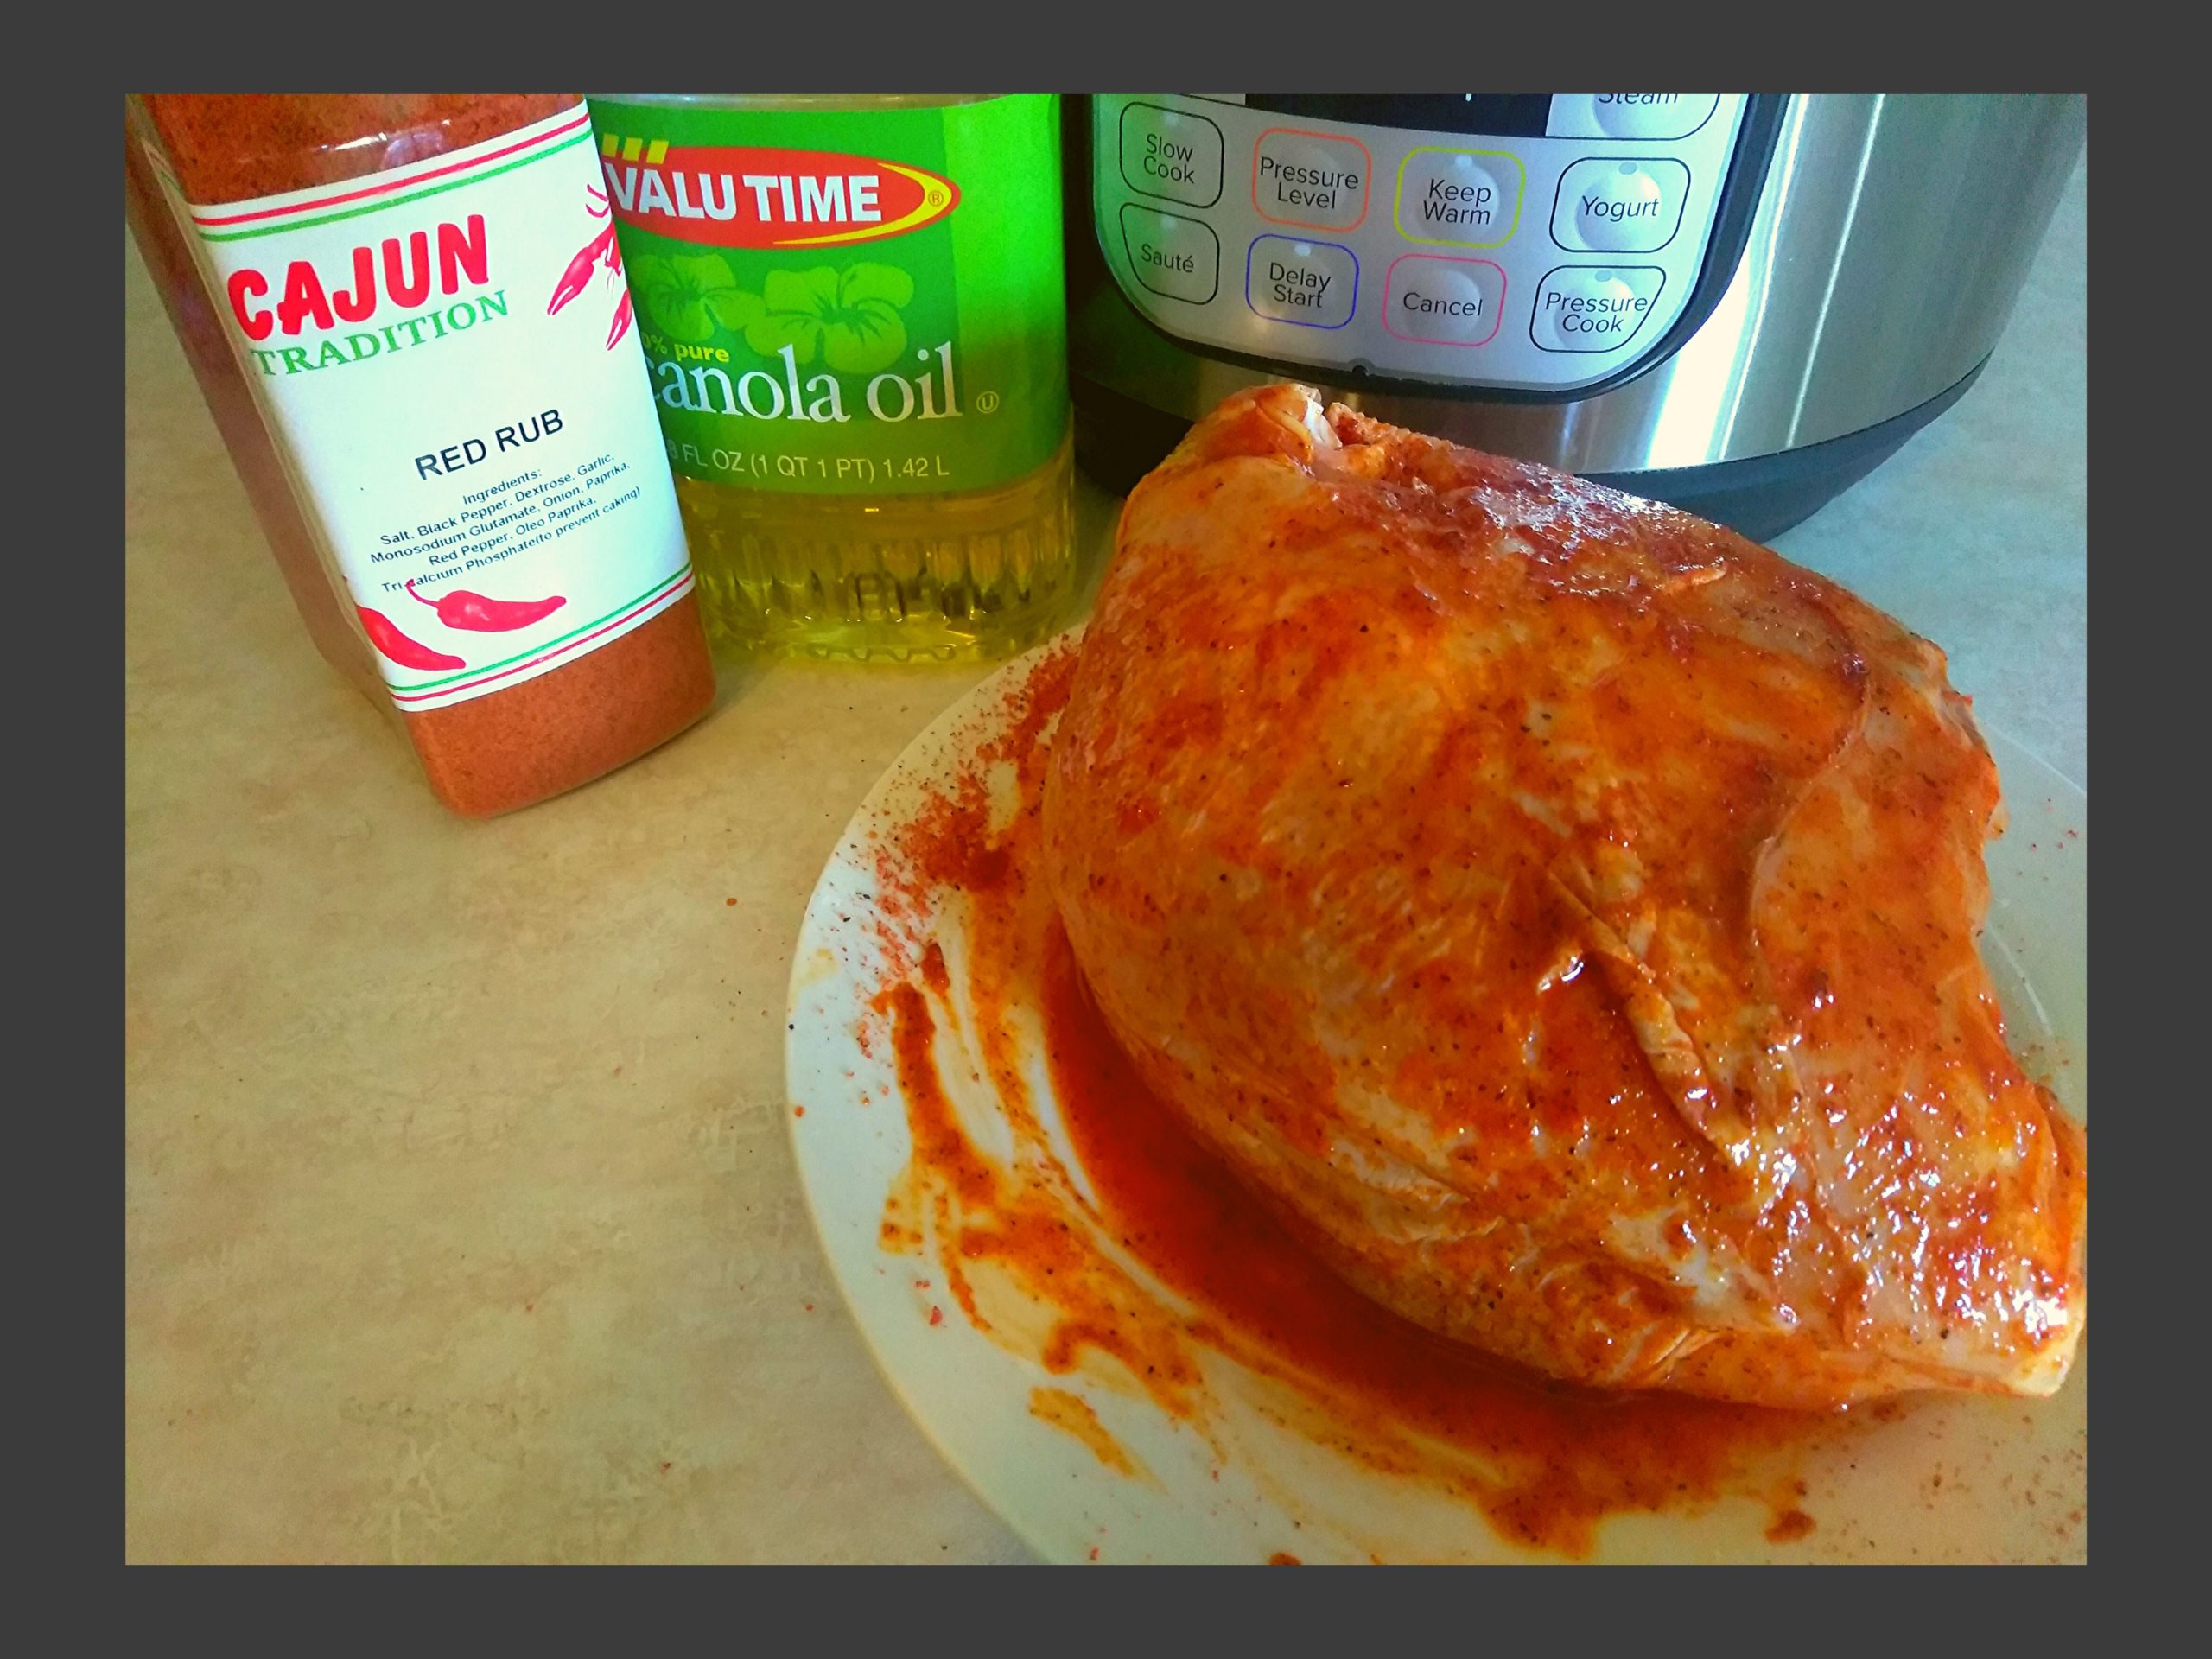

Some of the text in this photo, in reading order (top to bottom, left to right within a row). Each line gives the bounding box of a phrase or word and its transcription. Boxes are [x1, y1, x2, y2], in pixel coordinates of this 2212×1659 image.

[1146, 133, 1193, 162] Slow
[1143, 156, 1194, 184] Cook
[1260, 156, 1359, 189] Pressure
[604, 162, 737, 220] VALU
[742, 175, 882, 223] TIME
[1277, 182, 1336, 209] Level
[1428, 178, 1491, 210] Keep
[1423, 200, 1491, 225] Warm
[1581, 195, 1659, 222] Yogurt
[1141, 244, 1195, 273] Sauté
[227, 213, 489, 340] CAJUN
[1269, 262, 1331, 292] Delay
[1274, 283, 1323, 308] Start
[1403, 292, 1483, 316] Cancel
[1545, 292, 1648, 312] Pressure
[251, 290, 509, 378] TRADITION
[1562, 314, 1624, 333] Cook
[674, 343, 729, 363] pure
[867, 340, 963, 423] oil
[415, 409, 563, 480] RED RUB
[682, 443, 708, 467] FL
[712, 448, 745, 471] OZ
[778, 455, 809, 477] QT
[817, 458, 826, 478] 1
[836, 458, 874, 483] PT)
[883, 456, 929, 478] 1.42
[936, 455, 950, 476] L
[462, 469, 543, 505] Ingredients:
[556, 508, 601, 537] prevent
[602, 486, 641, 514] caking)
[416, 518, 459, 537] Black
[429, 550, 458, 566] Red
[515, 518, 545, 536] Oleo
[371, 531, 467, 563] Monosodium
